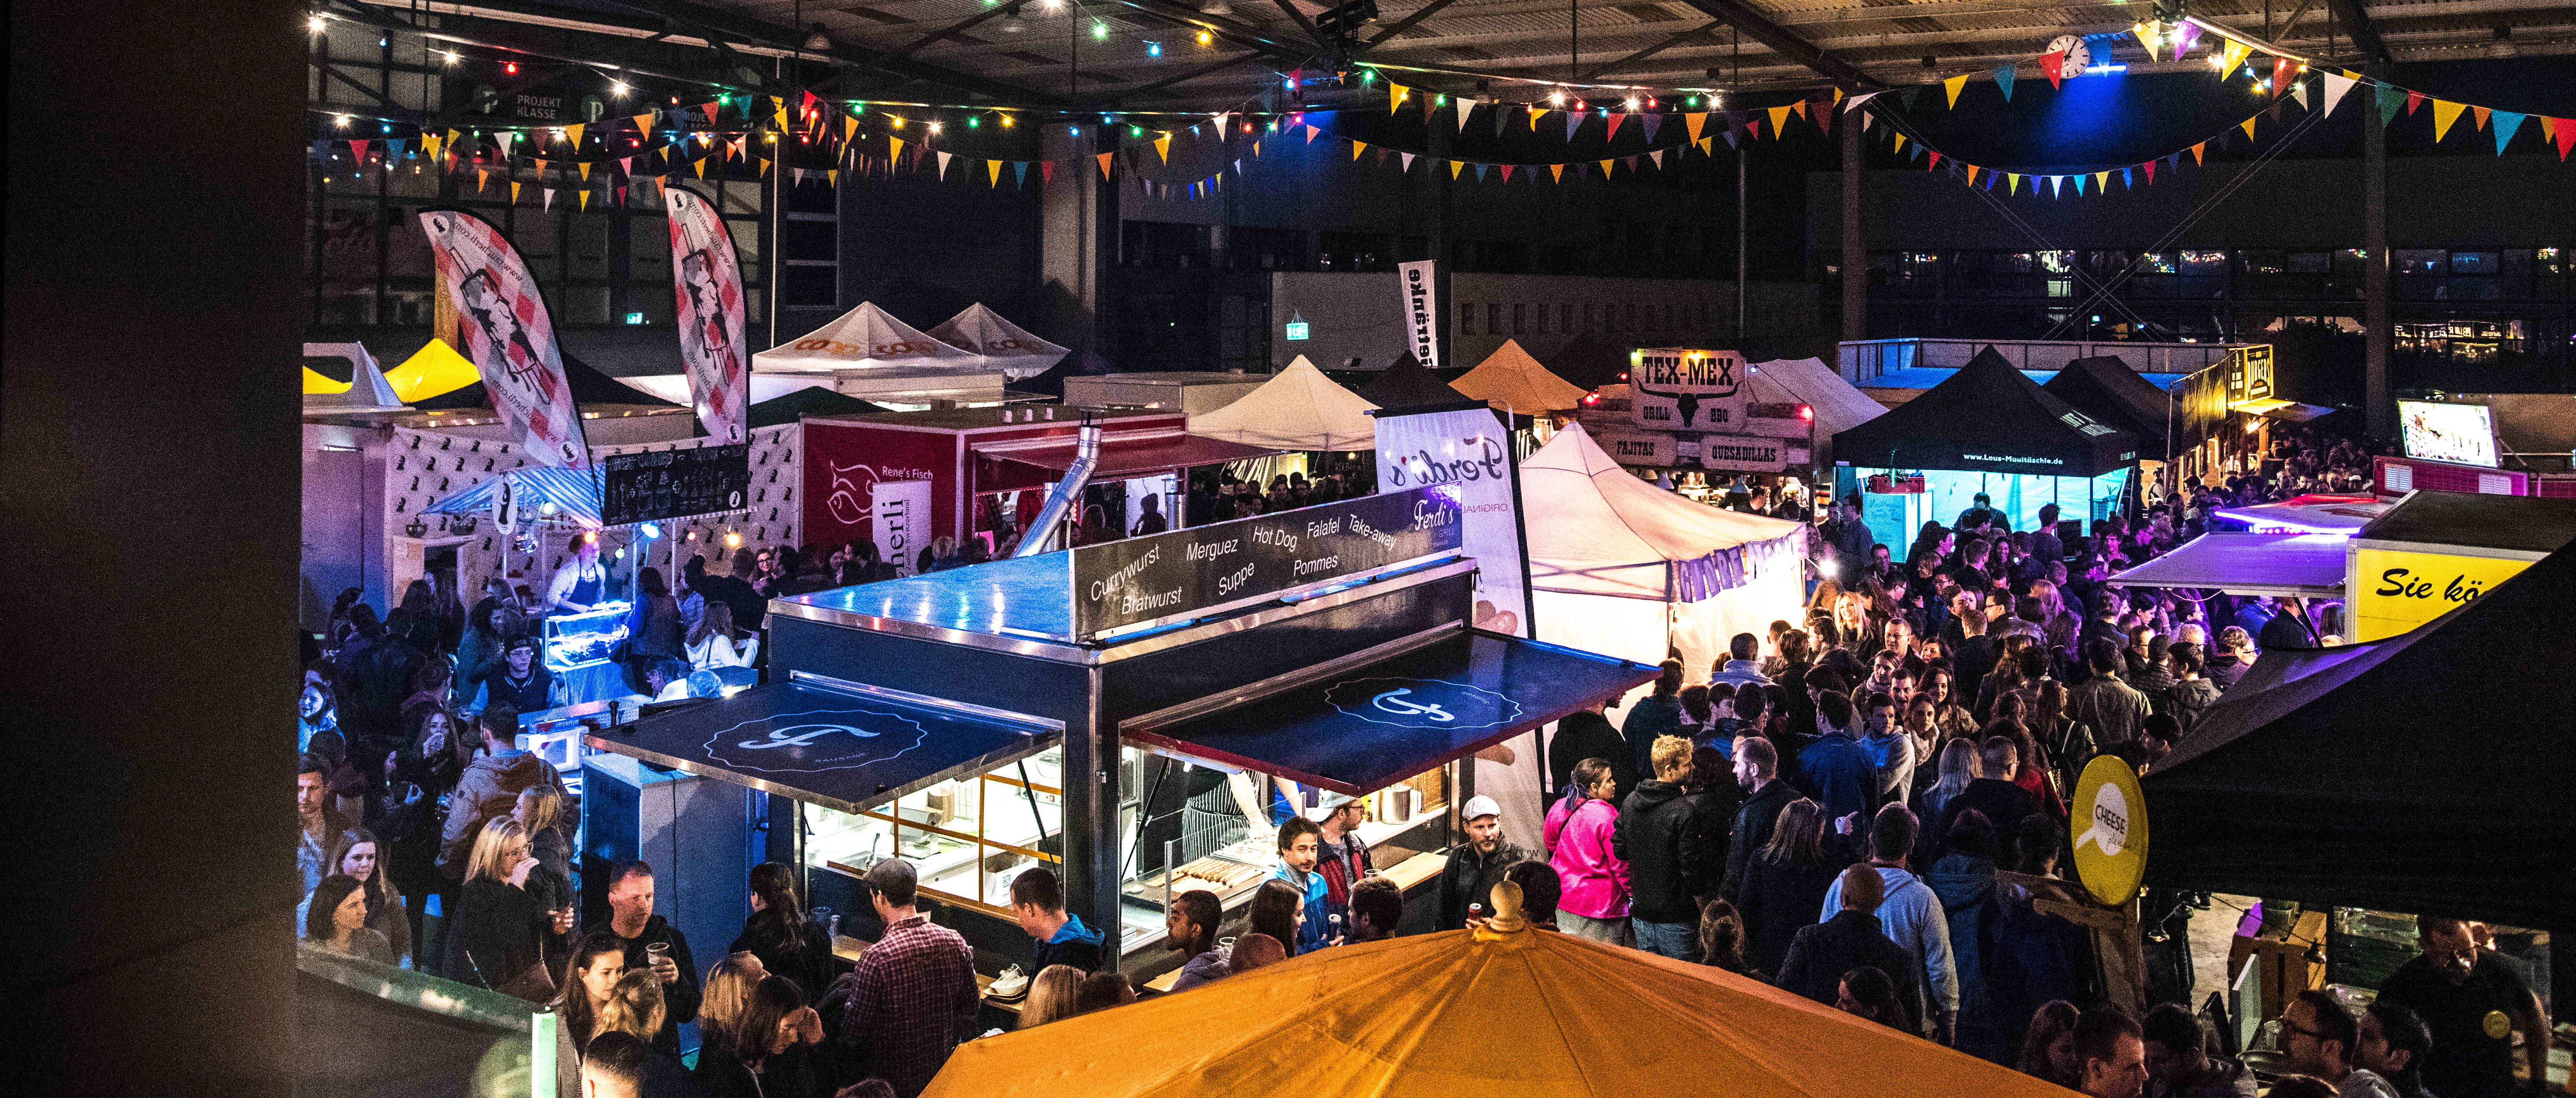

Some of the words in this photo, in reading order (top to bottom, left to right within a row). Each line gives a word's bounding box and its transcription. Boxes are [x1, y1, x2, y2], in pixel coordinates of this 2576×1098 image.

[516, 95, 562, 108] PROJEKT
[516, 108, 556, 120] KLASSE
[1642, 356, 1733, 386] TEX-MEX
[1643, 405, 1670, 420] GRILL
[1710, 407, 1729, 423] BBQ
[1617, 440, 1654, 456] FAJITAS
[1712, 444, 1776, 463] QUESADILLAS
[1963, 454, 2063, 465] www.Lous-Maultäschle.de
[882, 465, 910, 478] Rene's
[912, 469, 933, 480] Fisch
[1253, 526, 1274, 545] Hot
[1275, 530, 1298, 552] Dog
[1307, 516, 1340, 539] Falafel
[1349, 514, 1397, 551] Take-away
[1186, 537, 1238, 562] Merguez
[1091, 545, 1160, 601] Currywurst
[1293, 554, 1338, 577] Pommes
[1219, 562, 1255, 596] Suppe
[2376, 568, 2434, 599] Sie
[1122, 586, 1182, 615] Bratwurst
[2095, 803, 2125, 835] CHEESE
